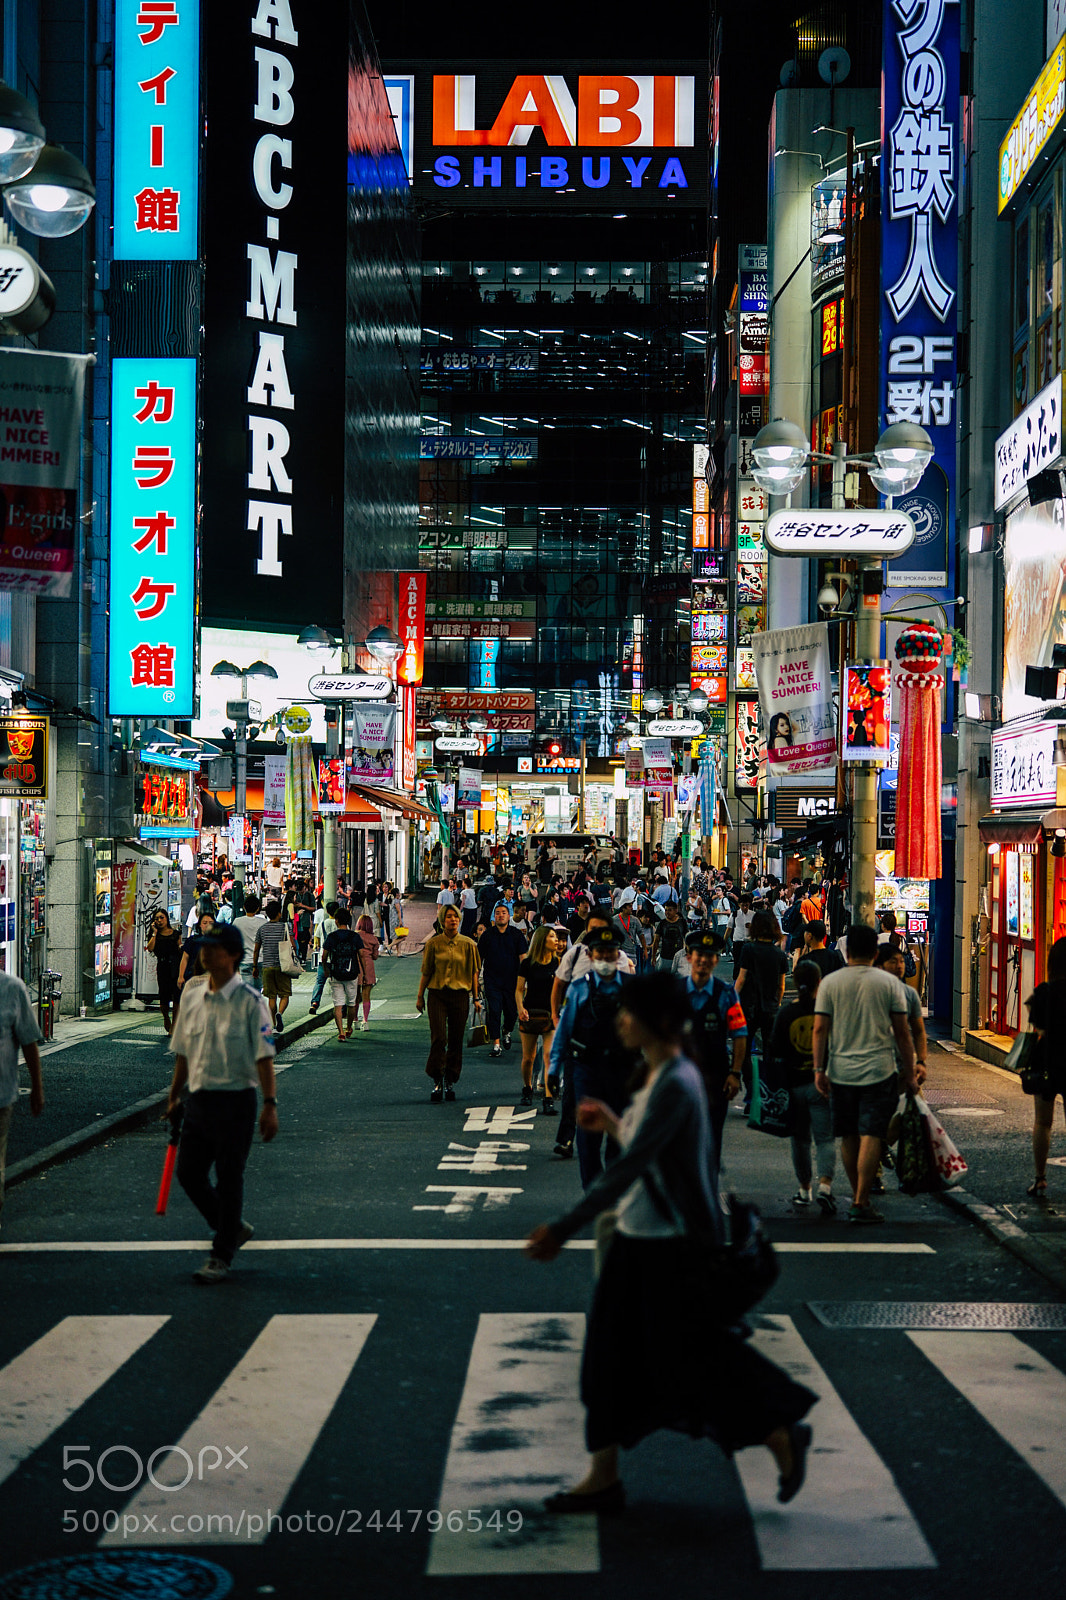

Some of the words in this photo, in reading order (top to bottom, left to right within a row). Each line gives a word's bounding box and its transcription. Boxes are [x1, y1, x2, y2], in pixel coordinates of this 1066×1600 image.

[432, 75, 695, 147] LABI
[433, 156, 689, 188] SHIBUYA
[888, 335, 953, 374] 2F
[886, 380, 955, 425] 受付
[0, 407, 44, 426] HAVE
[7, 428, 49, 446] NICE
[130, 379, 176, 688] カラオケ館
[776, 522, 907, 540] 渋谷センター街
[12, 545, 61, 562] Queen
[779, 661, 809, 674] HAVE
[313, 681, 387, 691] 渋谷センター街
[777, 677, 785, 687] A
[787, 671, 815, 684] NICE
[771, 682, 821, 699] SUMMER!
[777, 746, 800, 757] Love
[806, 740, 833, 752] Queen
[3, 764, 36, 783] HUB
